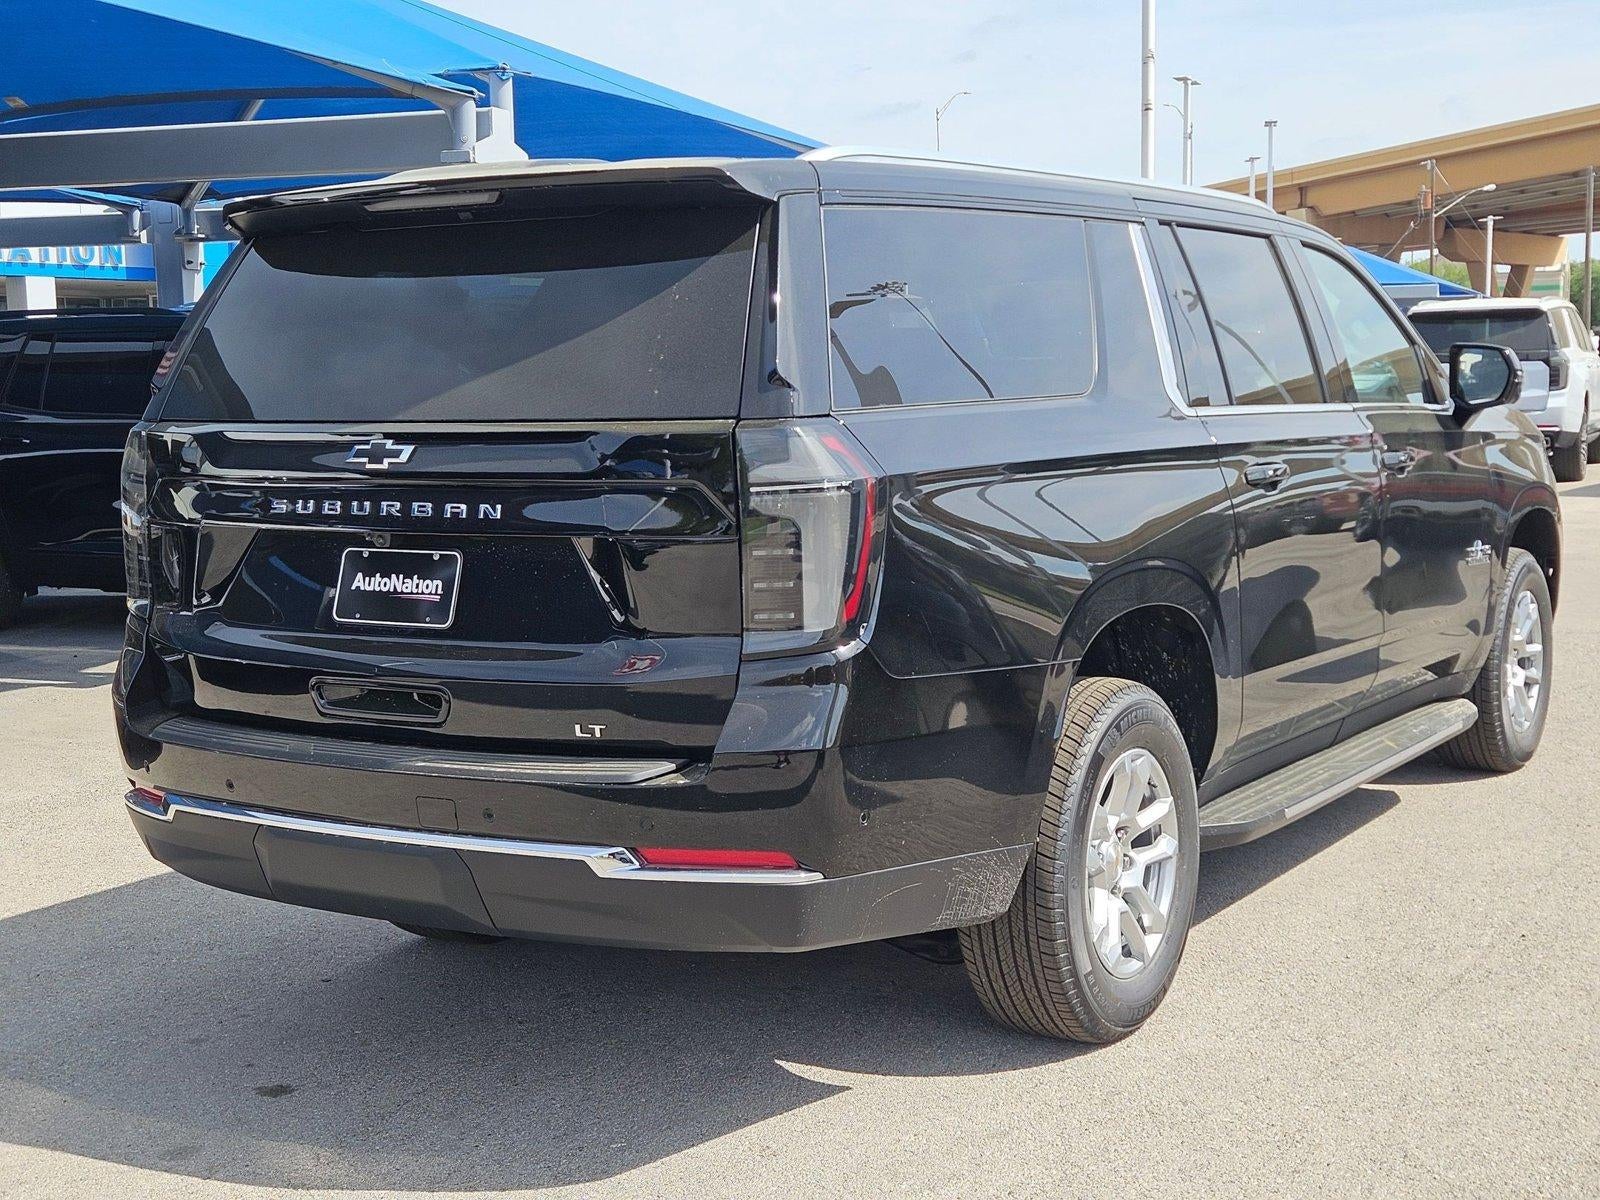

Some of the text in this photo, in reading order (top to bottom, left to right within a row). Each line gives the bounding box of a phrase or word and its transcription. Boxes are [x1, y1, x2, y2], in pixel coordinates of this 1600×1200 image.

[269, 499, 502, 519] SUBURBAN
[351, 572, 443, 594] AutoNation
[574, 724, 607, 738] LT
